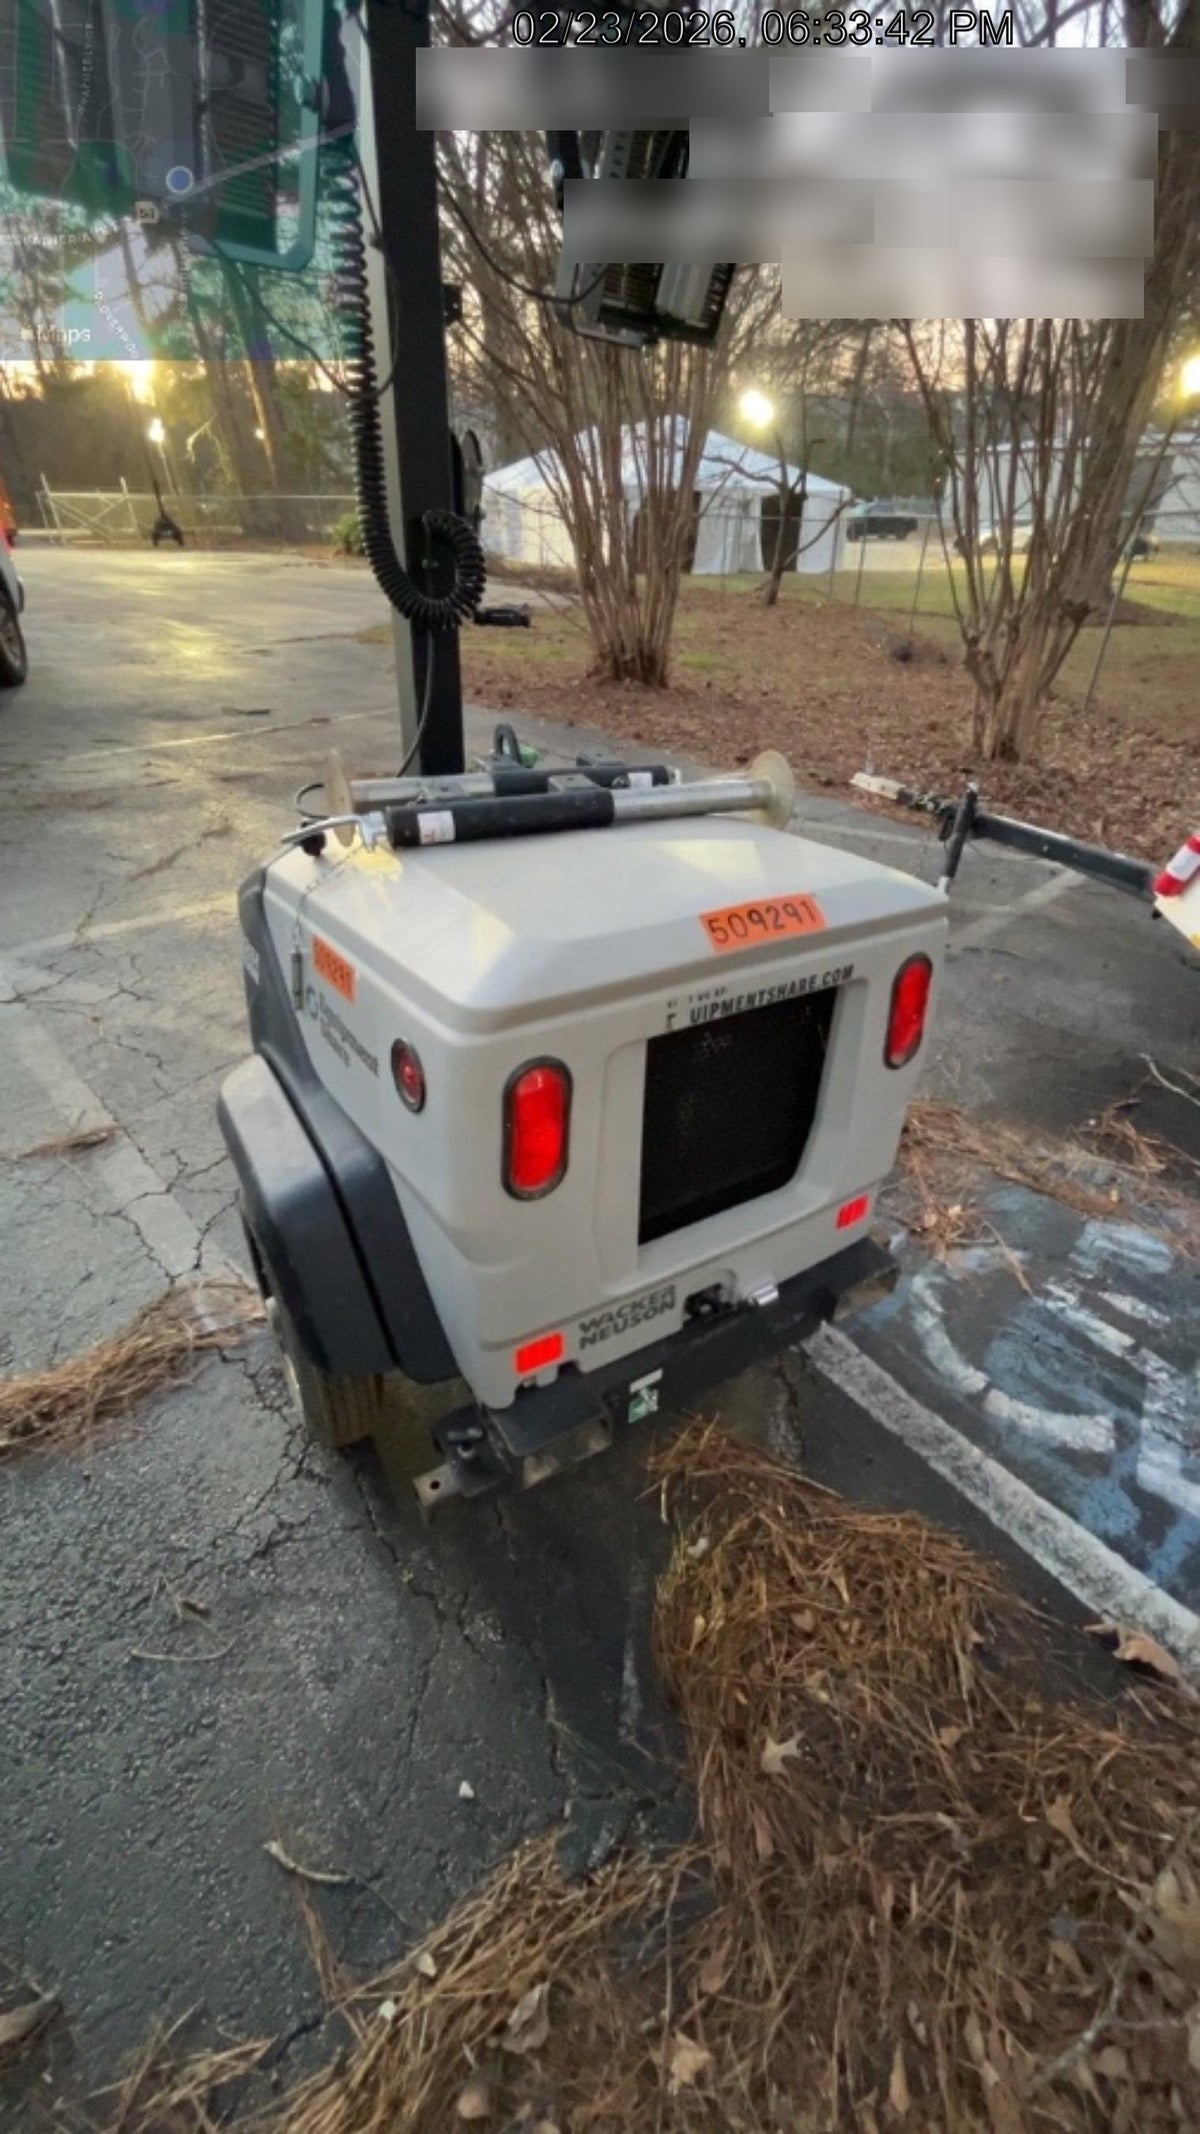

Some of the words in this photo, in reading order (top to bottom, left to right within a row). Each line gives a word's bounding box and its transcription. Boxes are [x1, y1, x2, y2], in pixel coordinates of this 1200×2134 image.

[708, 900, 817, 944] 509291
[579, 1284, 676, 1333] WACKER
[579, 1300, 676, 1350] NEUSON
